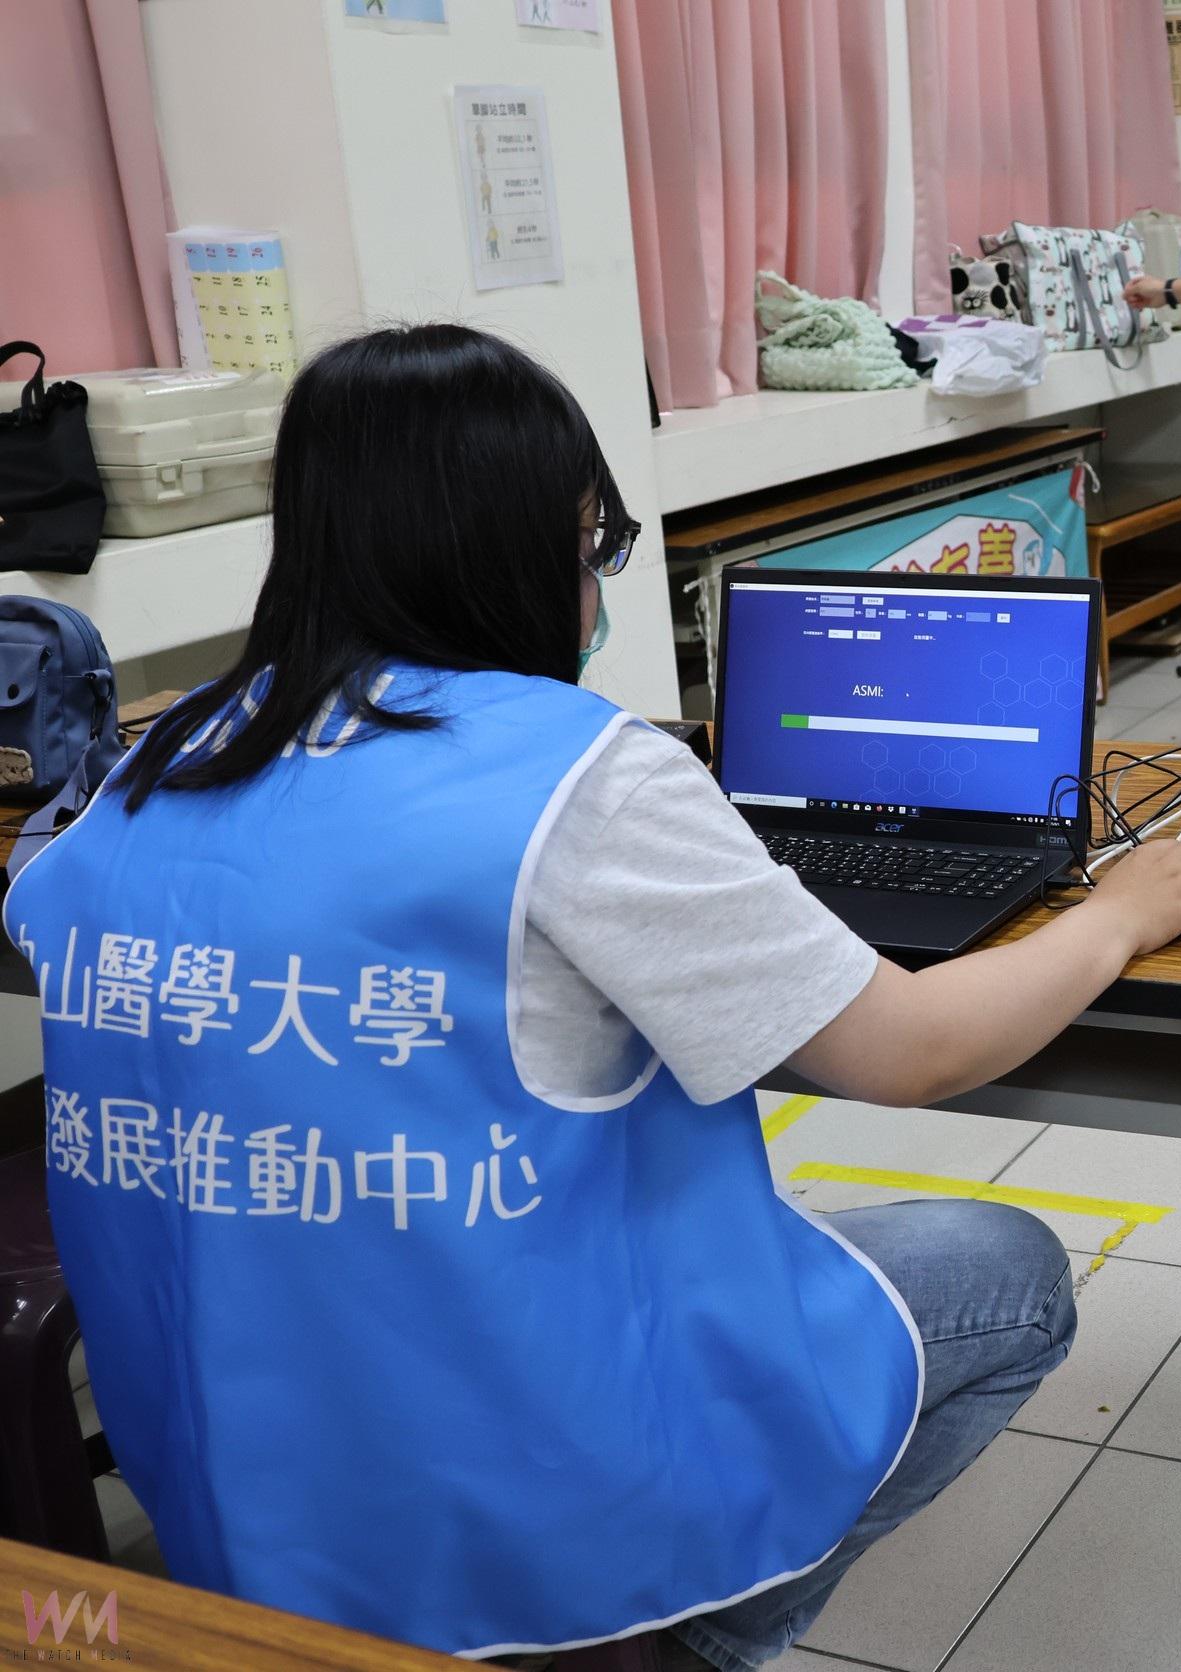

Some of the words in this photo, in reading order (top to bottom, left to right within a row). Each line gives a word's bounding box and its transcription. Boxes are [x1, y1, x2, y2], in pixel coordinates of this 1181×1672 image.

[853, 684, 884, 697] ASMI:
[875, 822, 905, 833] acer
[46, 1085, 541, 1230] 發展推動中心
